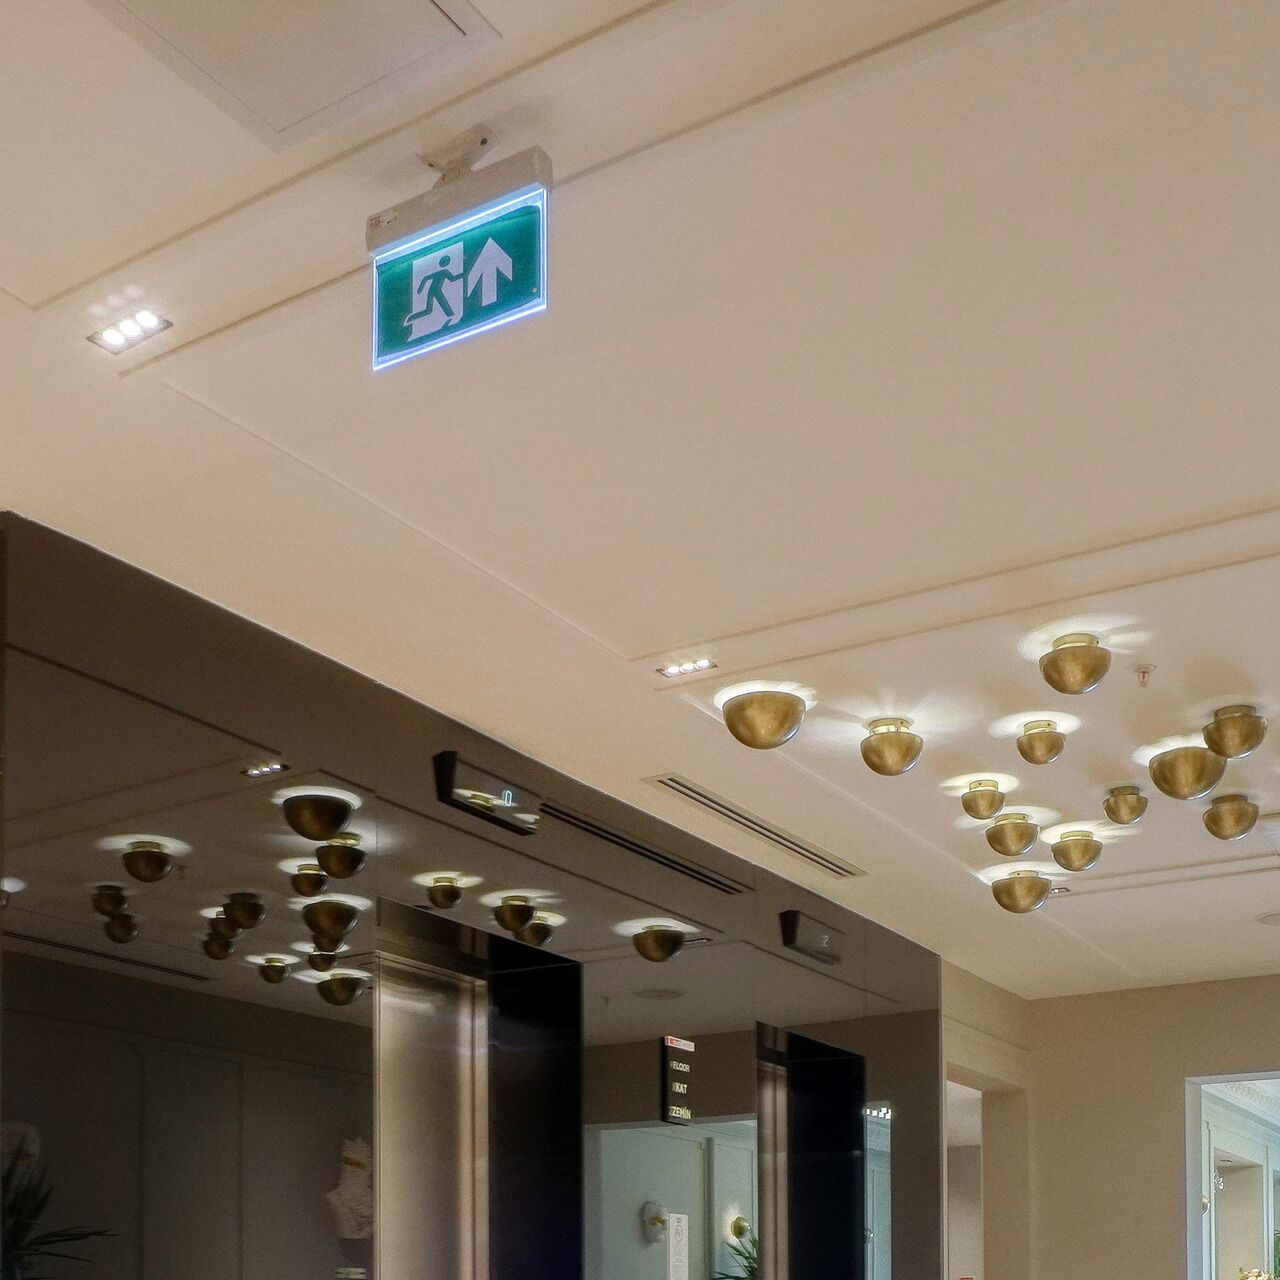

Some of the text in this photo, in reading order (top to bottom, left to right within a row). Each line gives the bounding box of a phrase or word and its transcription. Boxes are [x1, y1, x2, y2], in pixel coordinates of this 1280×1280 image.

[505, 790, 513, 807] 0
[673, 1061, 691, 1073] FLOOR
[674, 1082, 687, 1094] KAT
